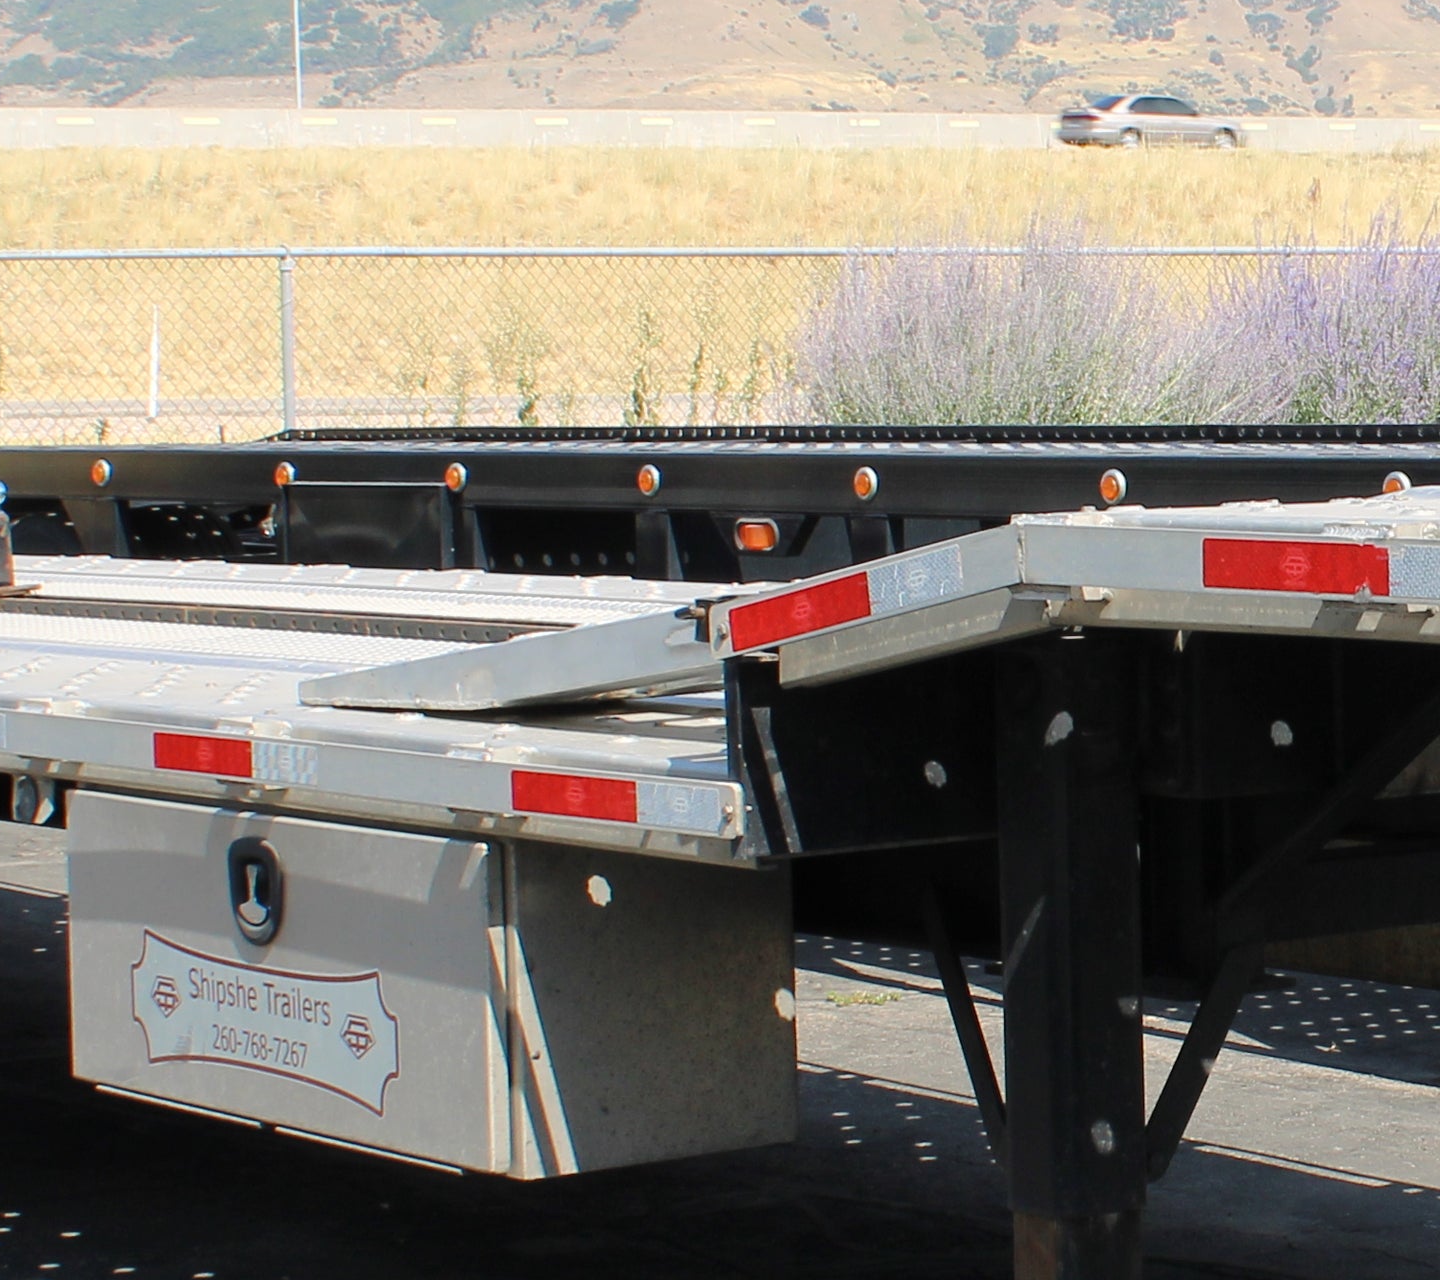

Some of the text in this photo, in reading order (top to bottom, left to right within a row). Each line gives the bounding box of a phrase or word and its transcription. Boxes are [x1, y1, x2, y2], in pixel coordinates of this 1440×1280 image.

[188, 967, 258, 1012] Shipshe
[262, 982, 332, 1026] Trailers
[212, 1023, 308, 1069] 260-768-7267
